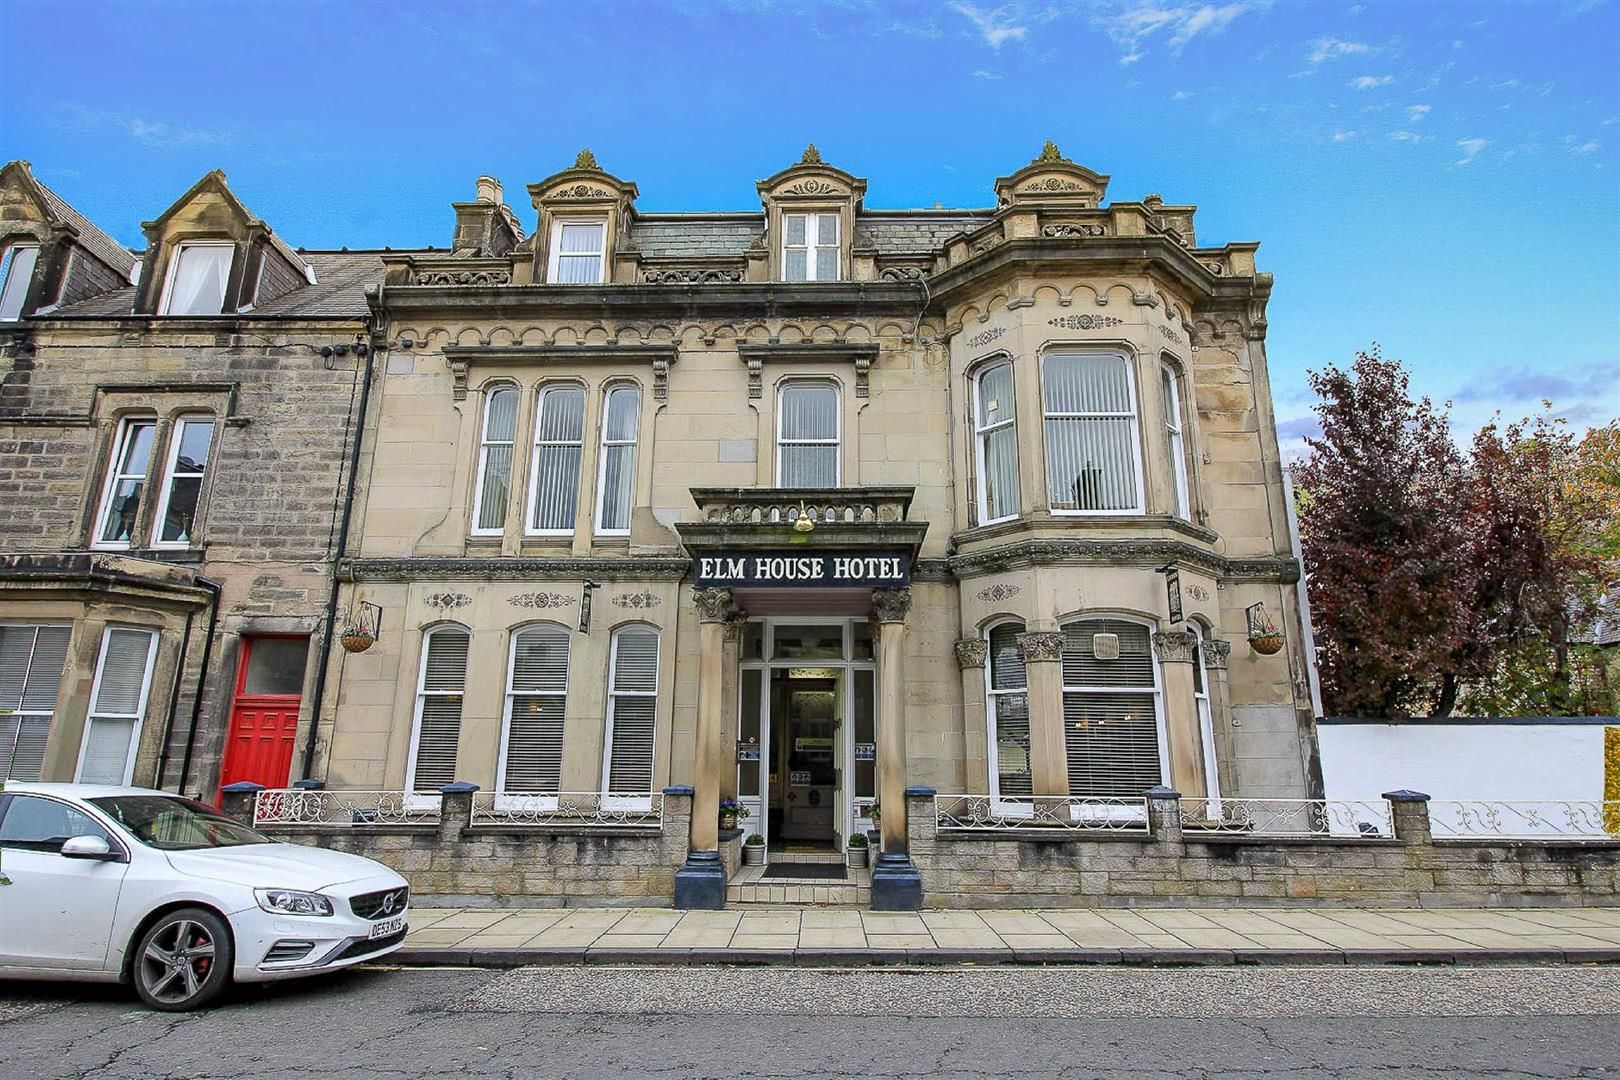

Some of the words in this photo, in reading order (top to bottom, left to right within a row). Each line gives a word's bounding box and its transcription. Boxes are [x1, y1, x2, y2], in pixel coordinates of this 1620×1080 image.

[700, 558, 746, 579] ELM
[755, 558, 824, 579] HOUSE
[833, 558, 904, 579] HOTEL
